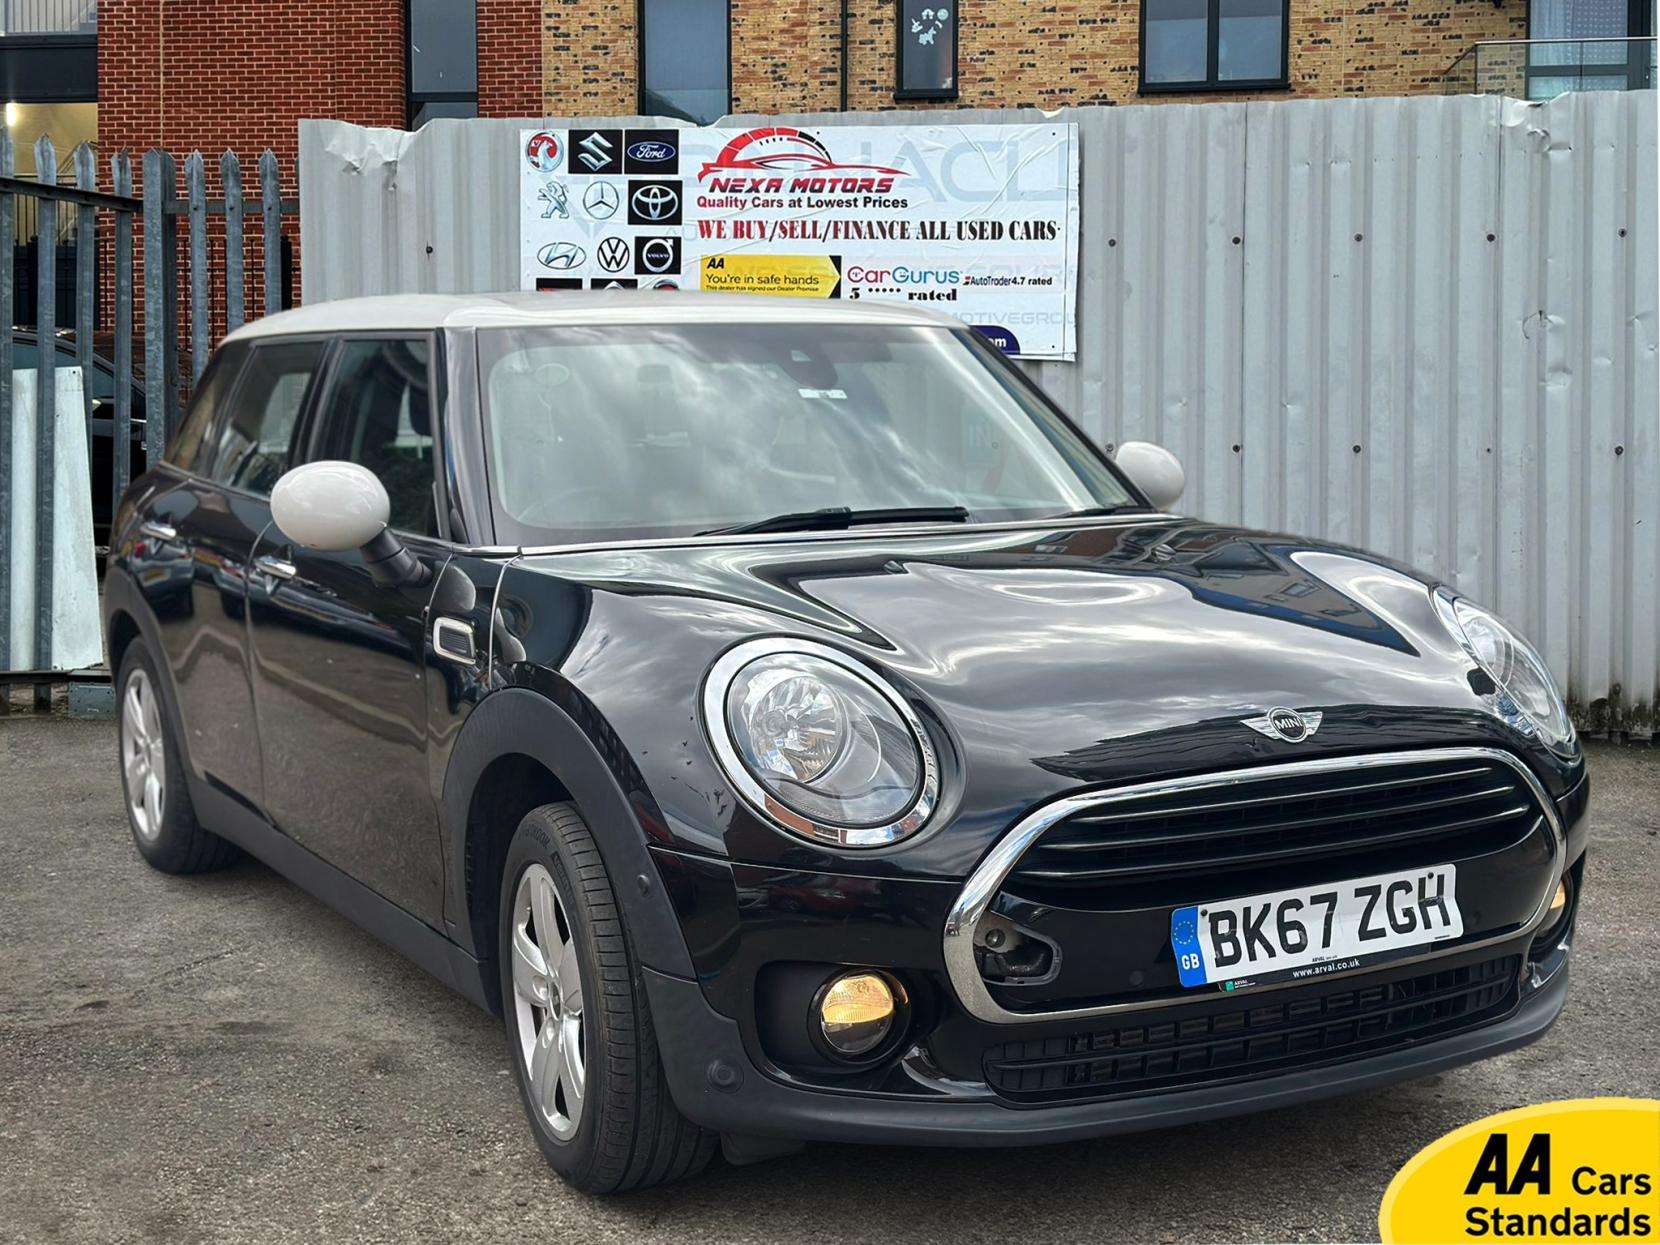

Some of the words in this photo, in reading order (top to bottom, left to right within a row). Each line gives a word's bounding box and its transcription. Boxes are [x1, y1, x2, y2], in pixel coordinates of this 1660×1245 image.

[636, 144, 666, 158] Ford
[709, 178, 784, 193] NEXA
[789, 178, 895, 193] MOTORS
[697, 196, 747, 210] Quality
[752, 196, 784, 208] Cars
[788, 196, 802, 208] at
[807, 196, 859, 208] Lowest
[863, 196, 908, 208] Prices
[697, 220, 727, 239] WE
[916, 220, 951, 240] ALL
[956, 220, 1004, 240] USED
[1009, 220, 1057, 240] CARS
[707, 257, 725, 269] AA
[706, 274, 741, 284] You're
[744, 274, 754, 284] in
[757, 274, 781, 284] safe
[784, 274, 820, 285] hands
[847, 266, 961, 284] CarGurus
[1028, 276, 1053, 286] rated
[849, 287, 860, 300] 5
[908, 289, 958, 301] rated
[1274, 717, 1303, 729] MINI
[1208, 891, 1338, 968] BK67
[1354, 873, 1451, 942] ZGH
[1181, 953, 1201, 970] GB
[1292, 958, 1361, 978] www.arval.co.uk
